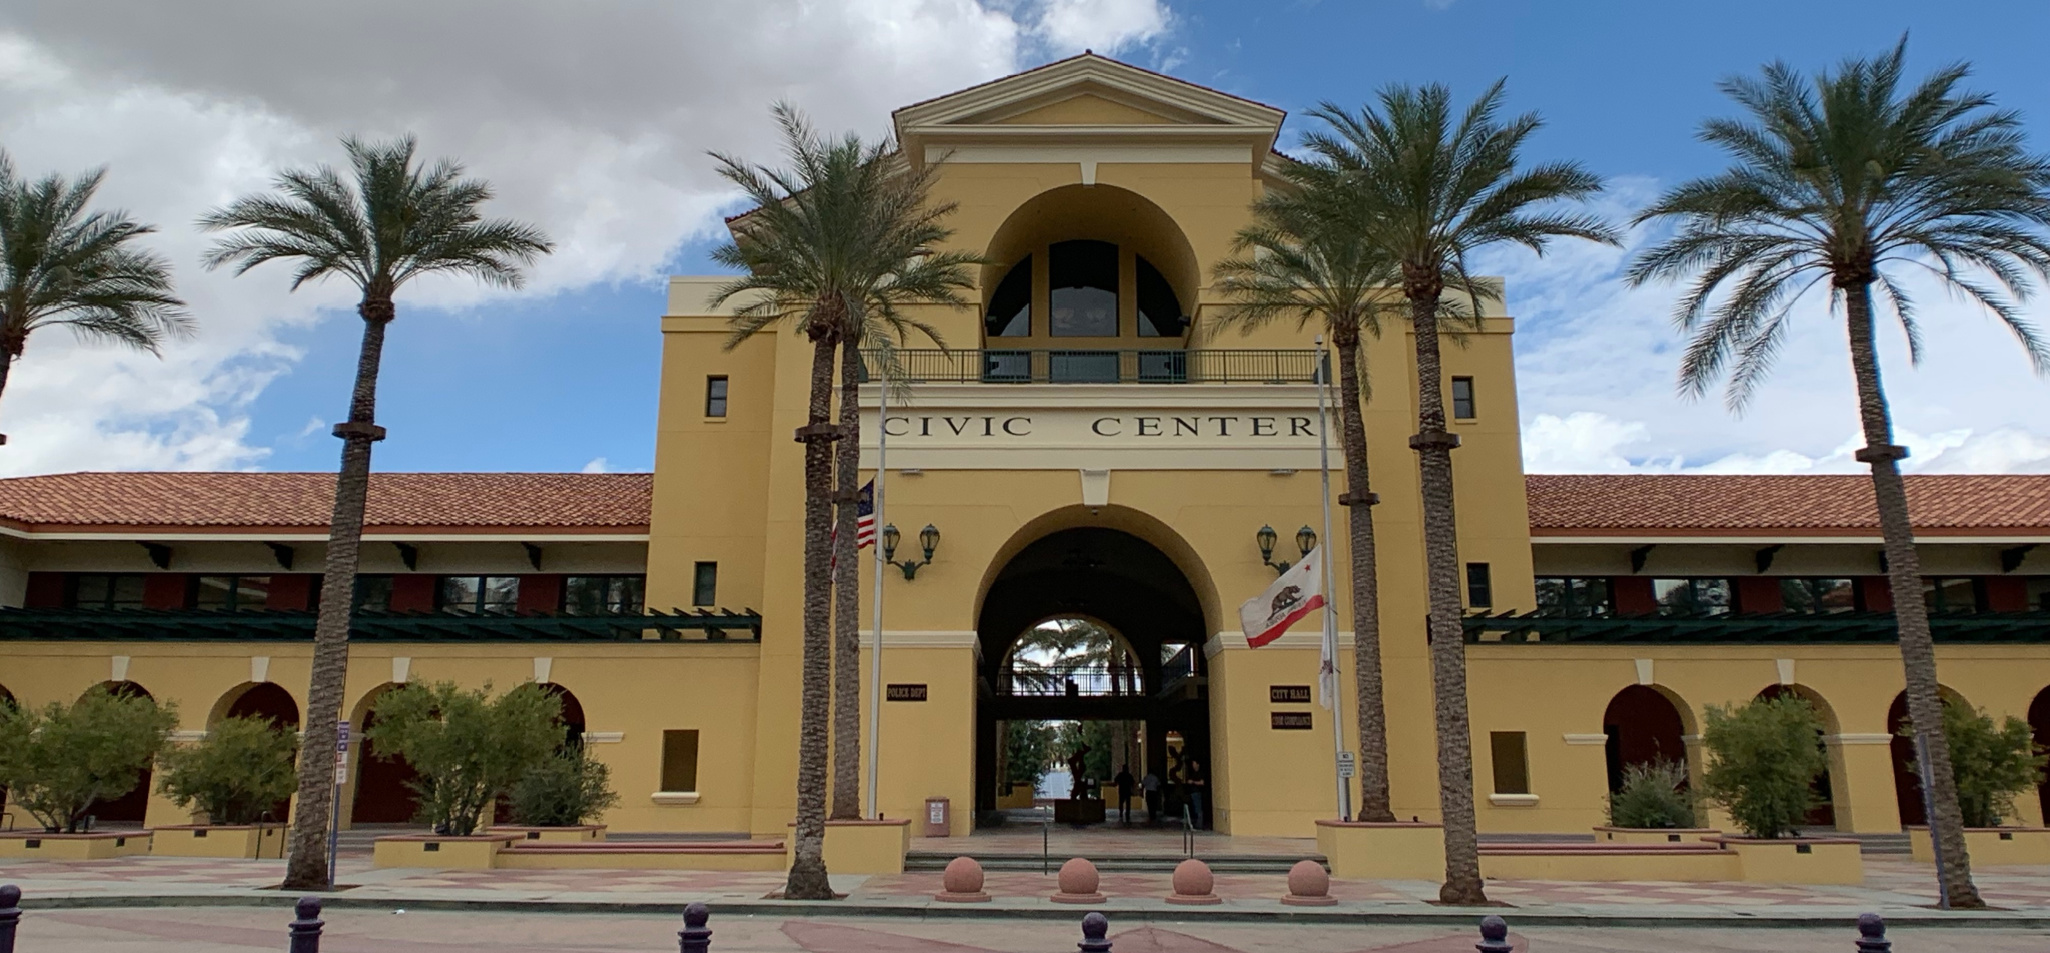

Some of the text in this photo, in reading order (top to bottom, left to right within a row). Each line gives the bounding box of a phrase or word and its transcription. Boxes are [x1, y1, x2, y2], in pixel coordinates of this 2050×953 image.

[883, 416, 1318, 437] CIVIC CENTER
[887, 687, 926, 698] POLICE DEPT
[1272, 689, 1309, 699] CITY HALL
